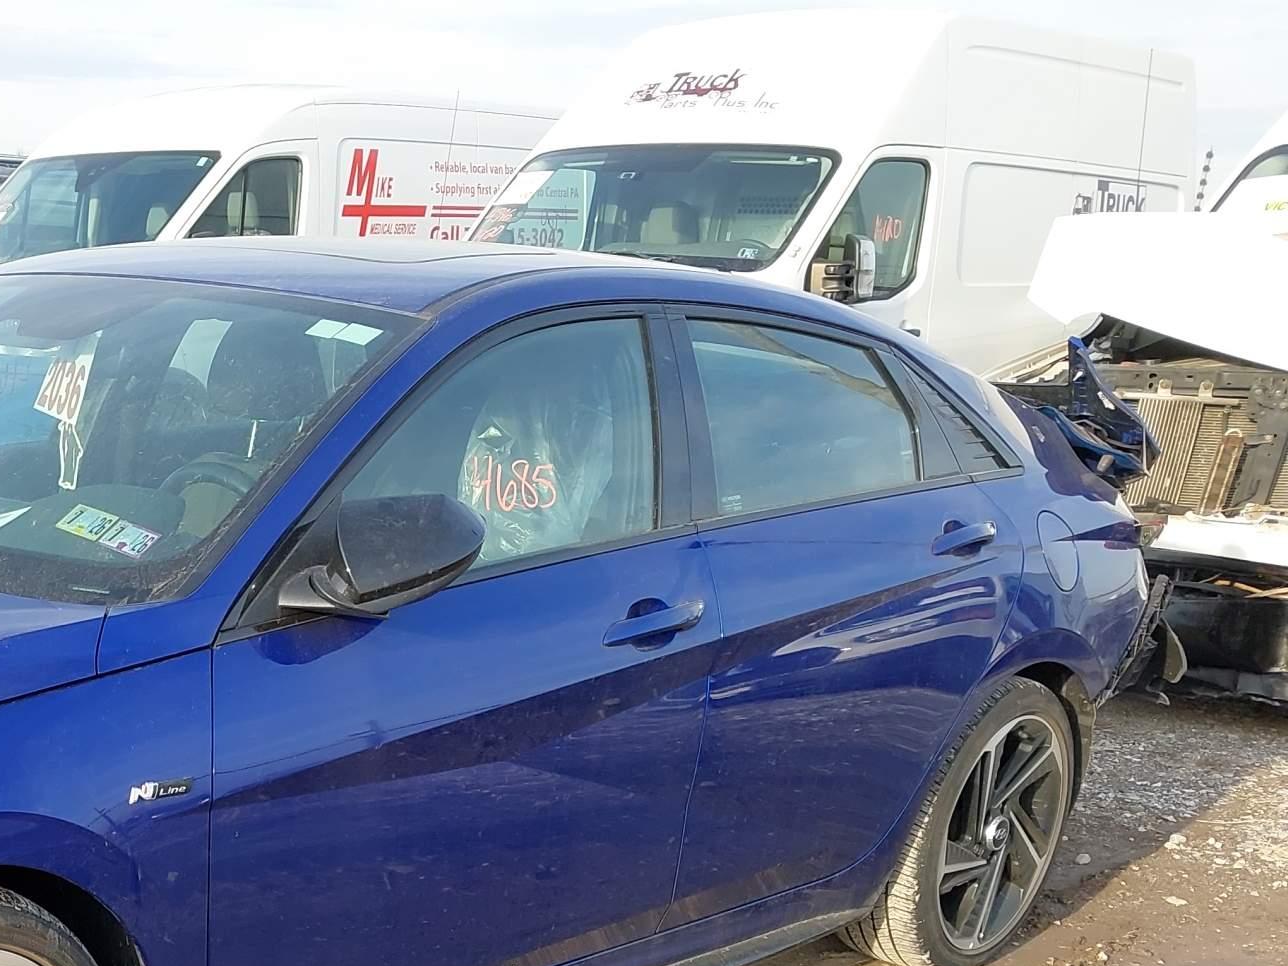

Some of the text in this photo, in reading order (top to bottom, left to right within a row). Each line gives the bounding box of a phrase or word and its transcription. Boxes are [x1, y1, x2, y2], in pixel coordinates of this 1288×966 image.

[665, 68, 747, 95] TRUCK
[754, 91, 780, 110] Inc
[346, 148, 394, 198] MIKE
[434, 161, 469, 174] Reliable,
[470, 163, 488, 173] local
[489, 165, 504, 174] van
[435, 183, 475, 198] Supplying
[477, 184, 492, 194] first
[394, 224, 416, 235] SERVICE
[36, 359, 86, 420] 2036
[470, 455, 557, 512] 4685
[159, 785, 187, 796] Line
